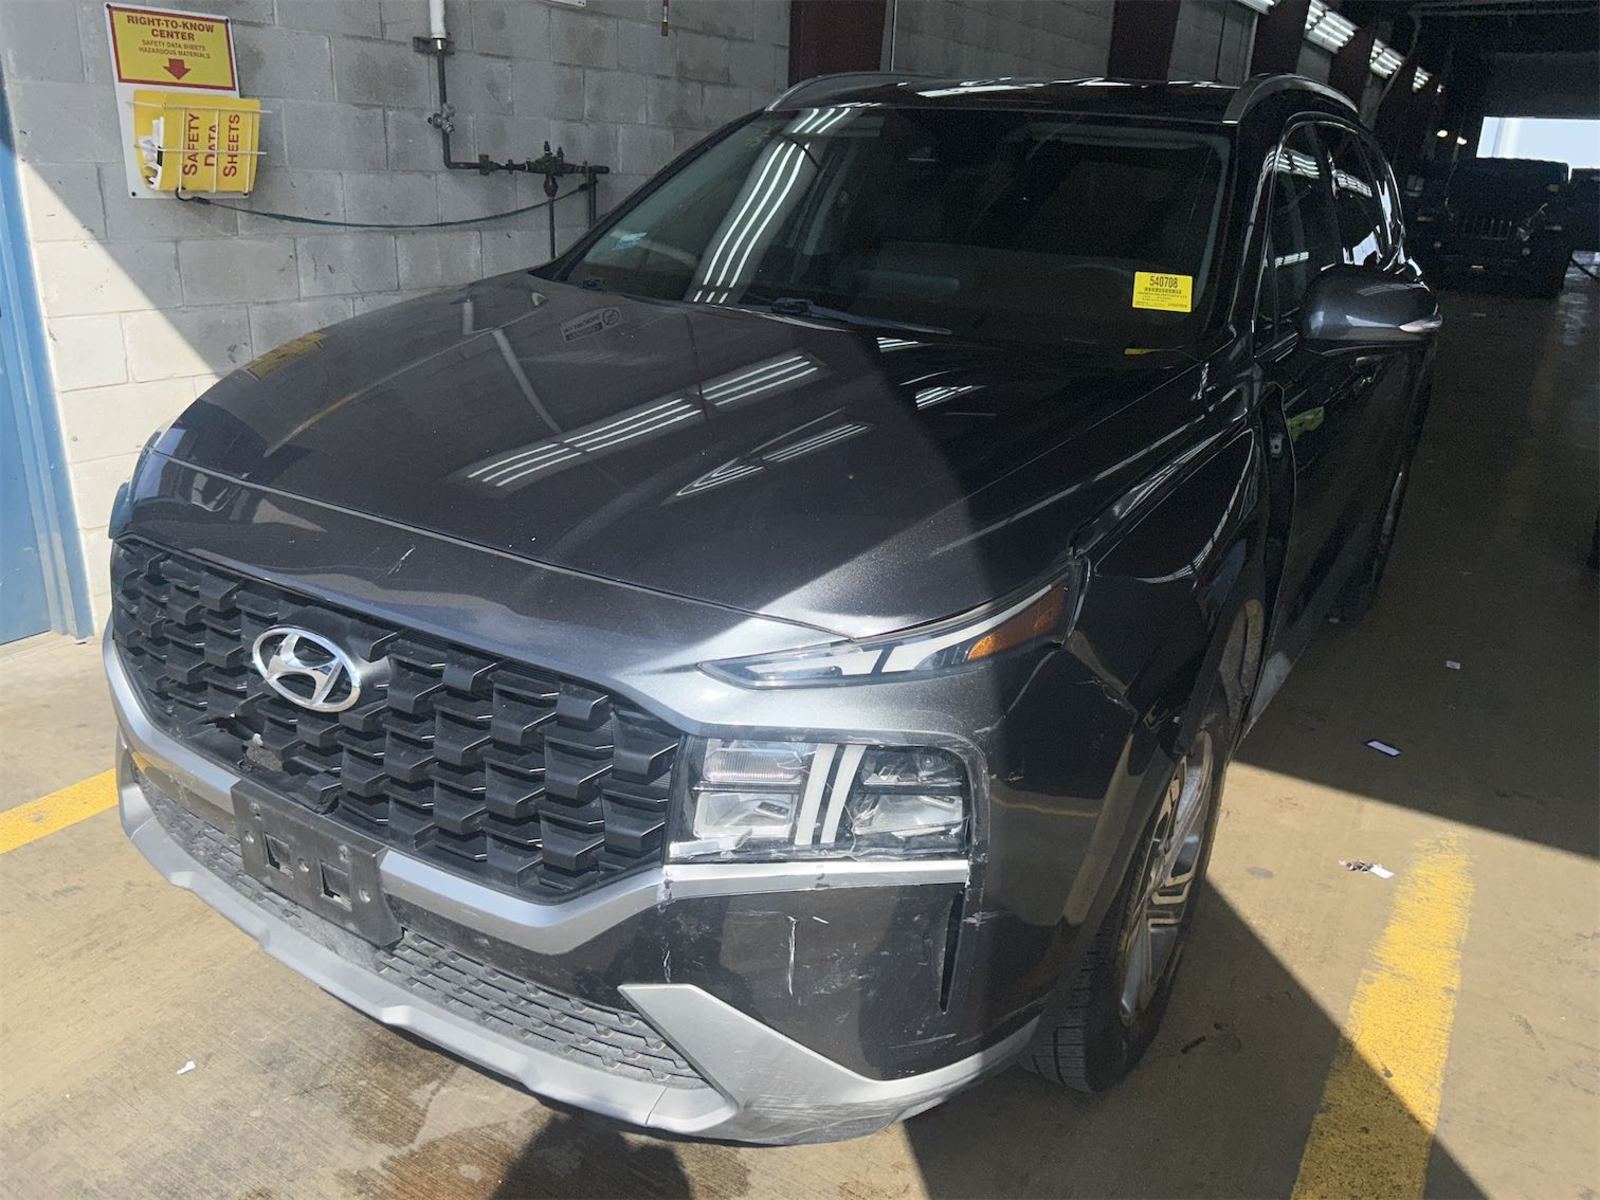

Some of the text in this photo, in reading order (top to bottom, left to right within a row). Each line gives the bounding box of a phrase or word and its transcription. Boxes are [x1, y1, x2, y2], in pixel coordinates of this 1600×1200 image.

[127, 15, 214, 33] RIGHT-TO-KNOW
[151, 28, 195, 41] CENTER
[139, 47, 210, 59] HAZARDOUS MATERIALS
[142, 39, 206, 52] SAFETY DATA SHEETS
[182, 113, 200, 176] SAFETY
[204, 124, 217, 167] DATA
[223, 113, 240, 177] SHEETS
[1149, 275, 1178, 288] 540708
